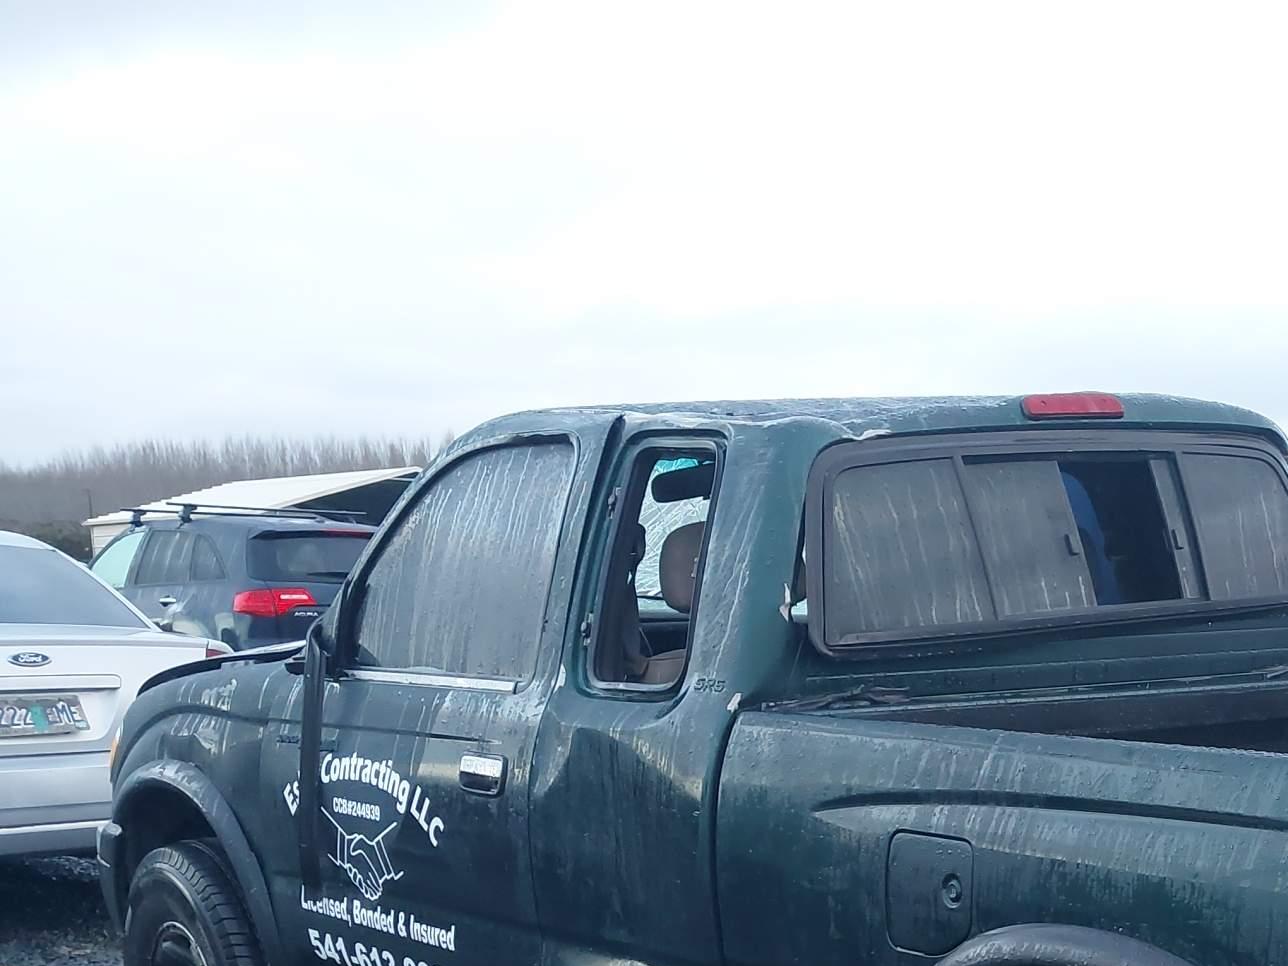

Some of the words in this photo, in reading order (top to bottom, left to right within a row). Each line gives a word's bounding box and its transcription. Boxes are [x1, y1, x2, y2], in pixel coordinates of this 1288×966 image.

[694, 678, 726, 693] SR5
[320, 752, 410, 814] Contracting
[409, 785, 445, 847] LLC
[333, 797, 381, 822] CCB#244939
[353, 899, 396, 936] Bonded
[397, 914, 408, 938] &
[409, 921, 456, 951] Insured
